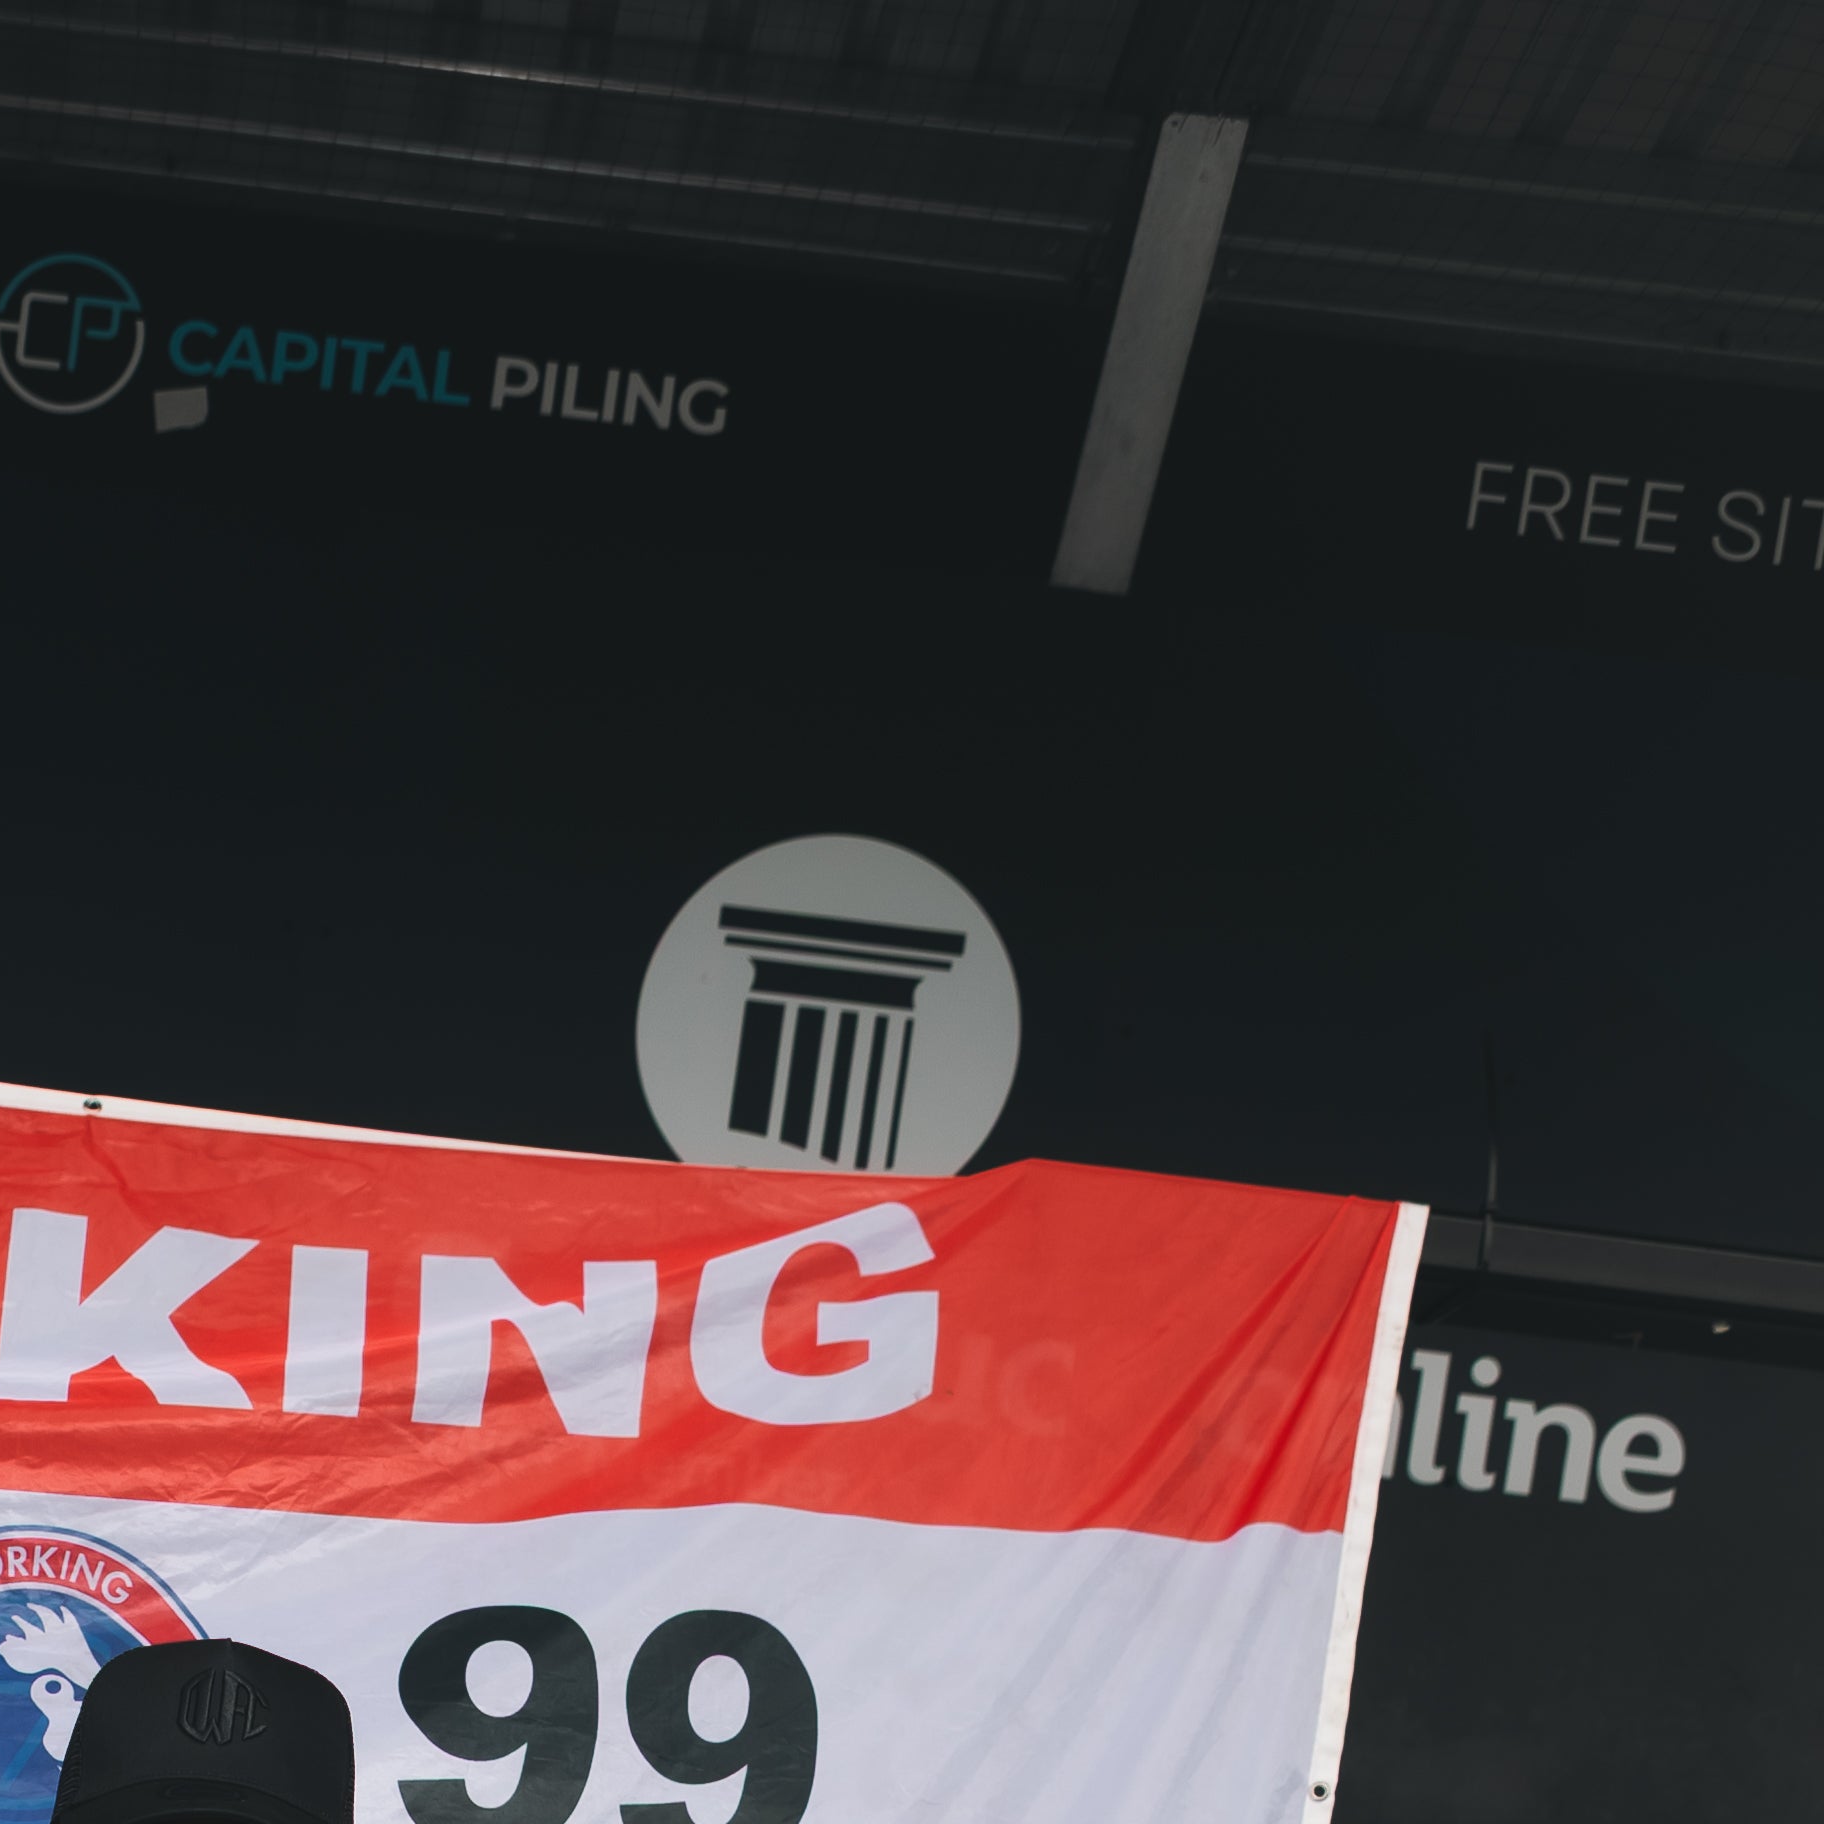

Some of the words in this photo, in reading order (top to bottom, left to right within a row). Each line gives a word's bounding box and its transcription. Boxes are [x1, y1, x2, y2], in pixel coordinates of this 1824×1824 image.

[168, 320, 470, 407] CAPITAL
[490, 355, 730, 436] PILING
[1465, 460, 1686, 555] FREE
